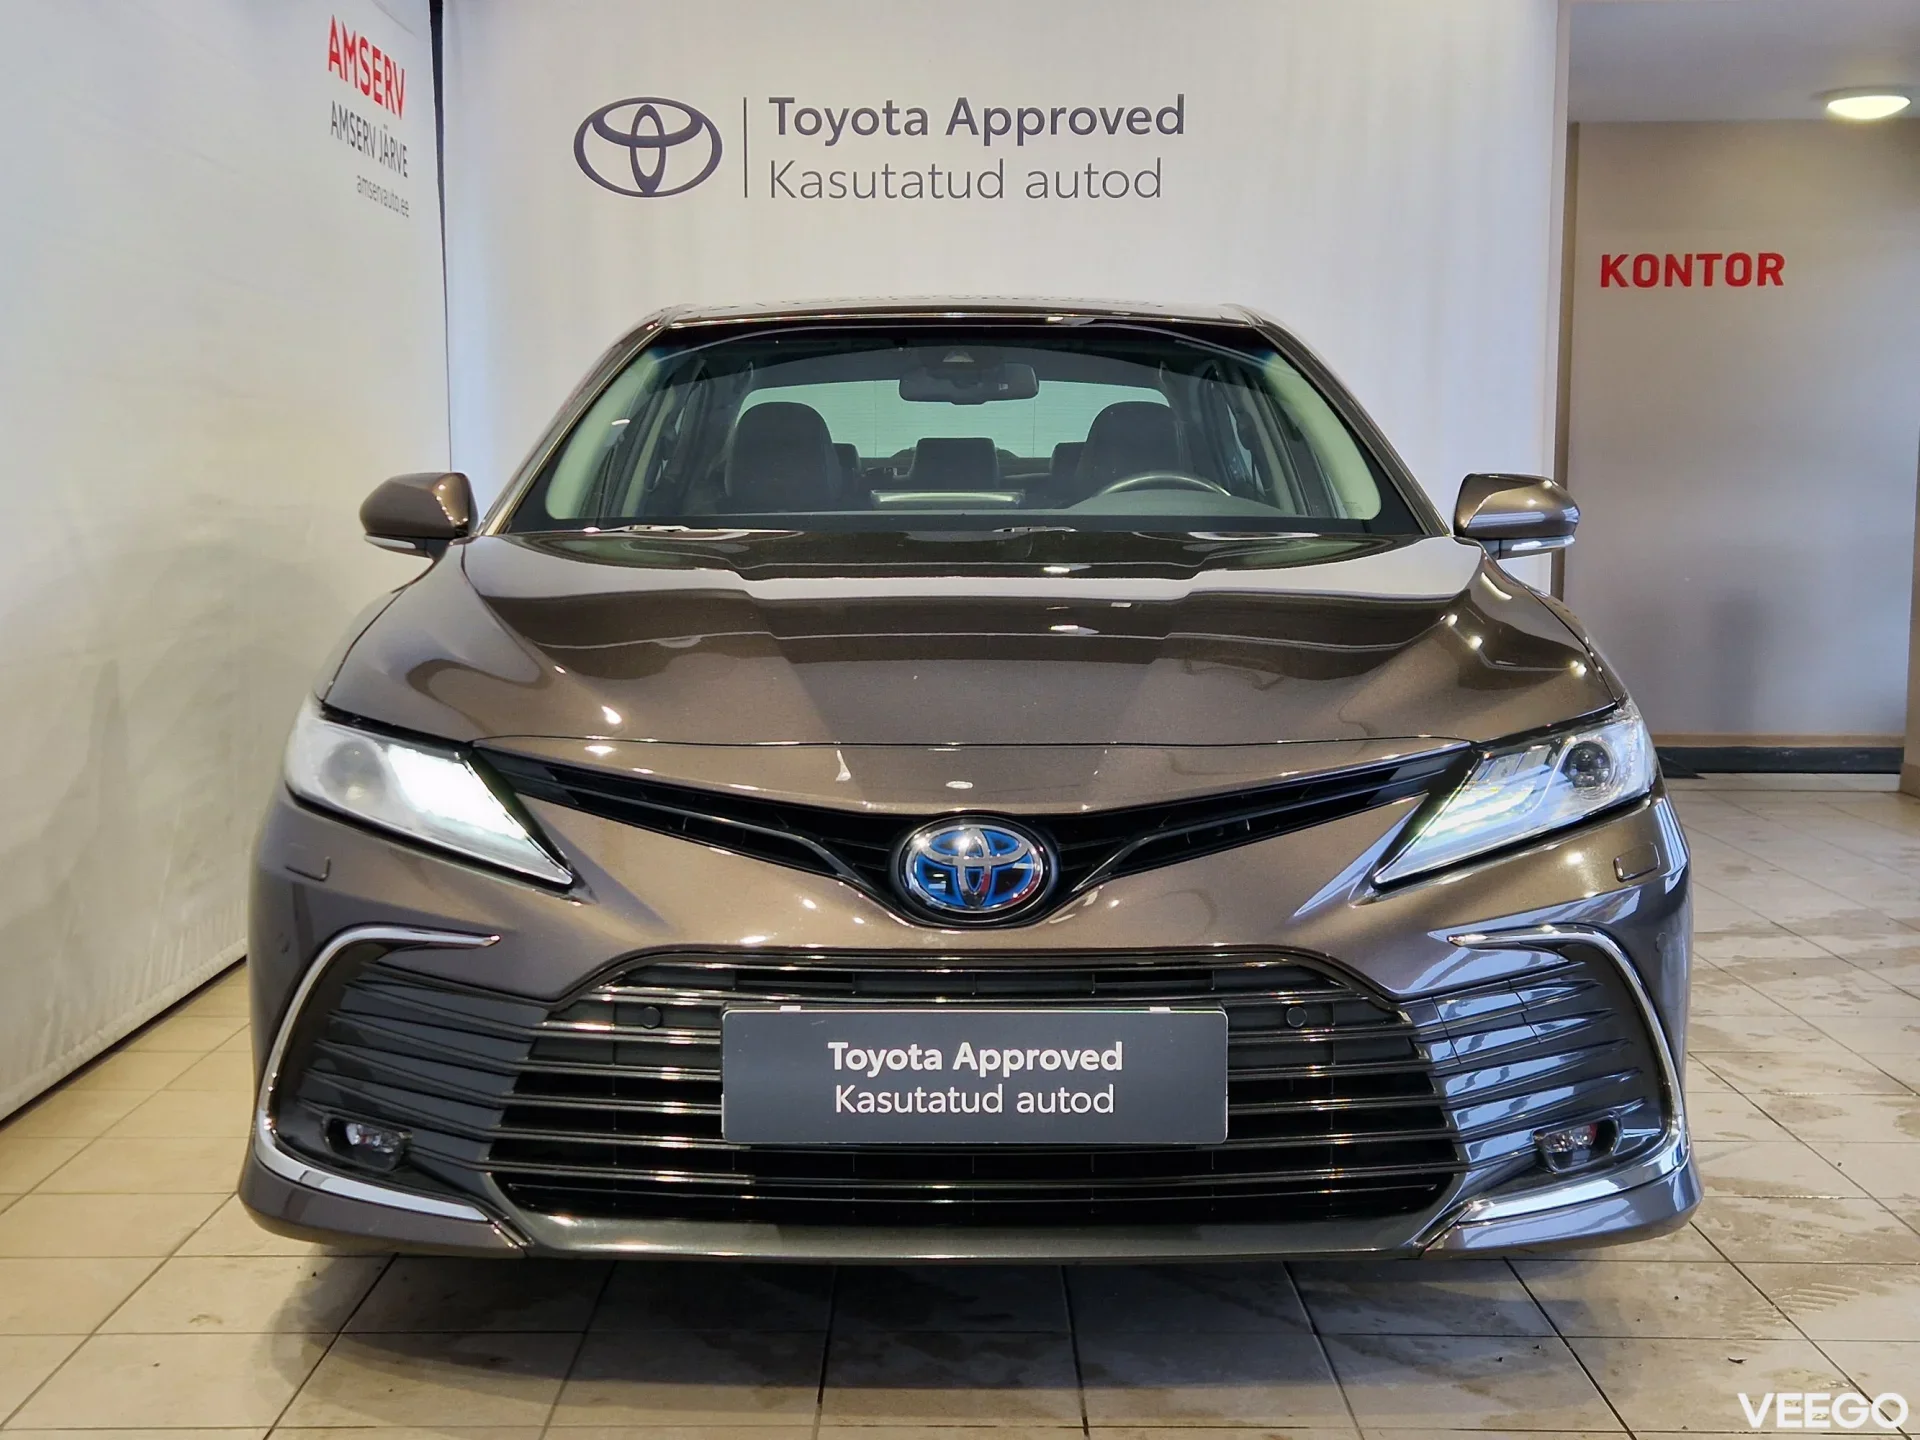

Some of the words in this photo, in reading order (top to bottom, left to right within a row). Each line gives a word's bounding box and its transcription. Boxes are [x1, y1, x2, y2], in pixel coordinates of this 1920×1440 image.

[328, 14, 404, 120] AMSERV
[330, 100, 376, 159] AMSERV
[379, 123, 408, 178] JÄRVE
[769, 97, 929, 146] Toyota
[946, 94, 1185, 147] Approved
[770, 159, 1004, 199] Kasutatud
[1026, 158, 1162, 199] autod
[1601, 252, 1785, 288] KONTOR
[827, 1042, 943, 1078] Toyota
[952, 1041, 1123, 1077] Approved
[835, 1084, 1003, 1113] Kasutatud
[1016, 1084, 1115, 1113] autod
